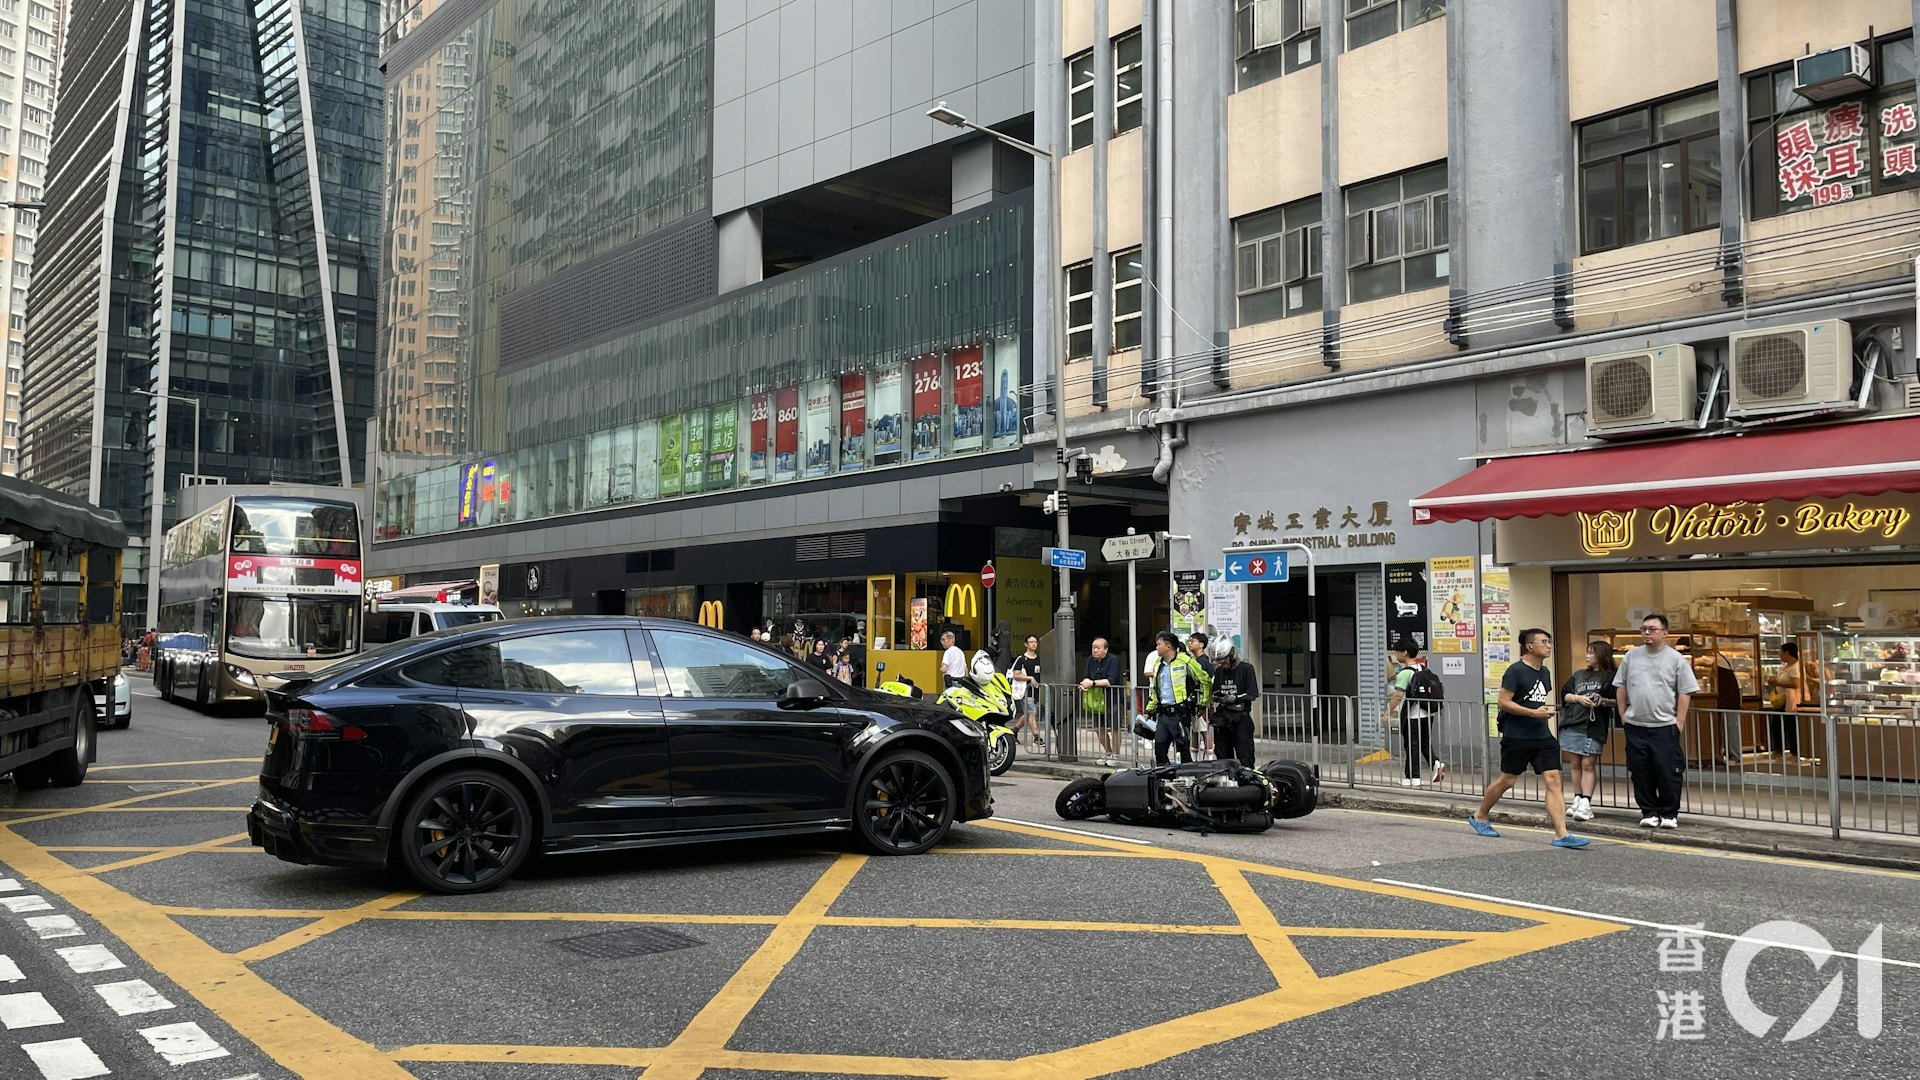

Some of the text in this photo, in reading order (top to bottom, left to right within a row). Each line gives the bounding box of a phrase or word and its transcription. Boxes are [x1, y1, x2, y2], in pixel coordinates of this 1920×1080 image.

[1881, 103, 1917, 176] 洗頭
[778, 406, 798, 423] 860
[1648, 502, 1910, 545] Victori Bakery
[1108, 536, 1148, 547] Tai Yau Street
[1347, 531, 1397, 548] BUILDING
[1116, 548, 1139, 558] 大有街
[1006, 597, 1043, 609] Advertising
[1016, 615, 1033, 624] Here
